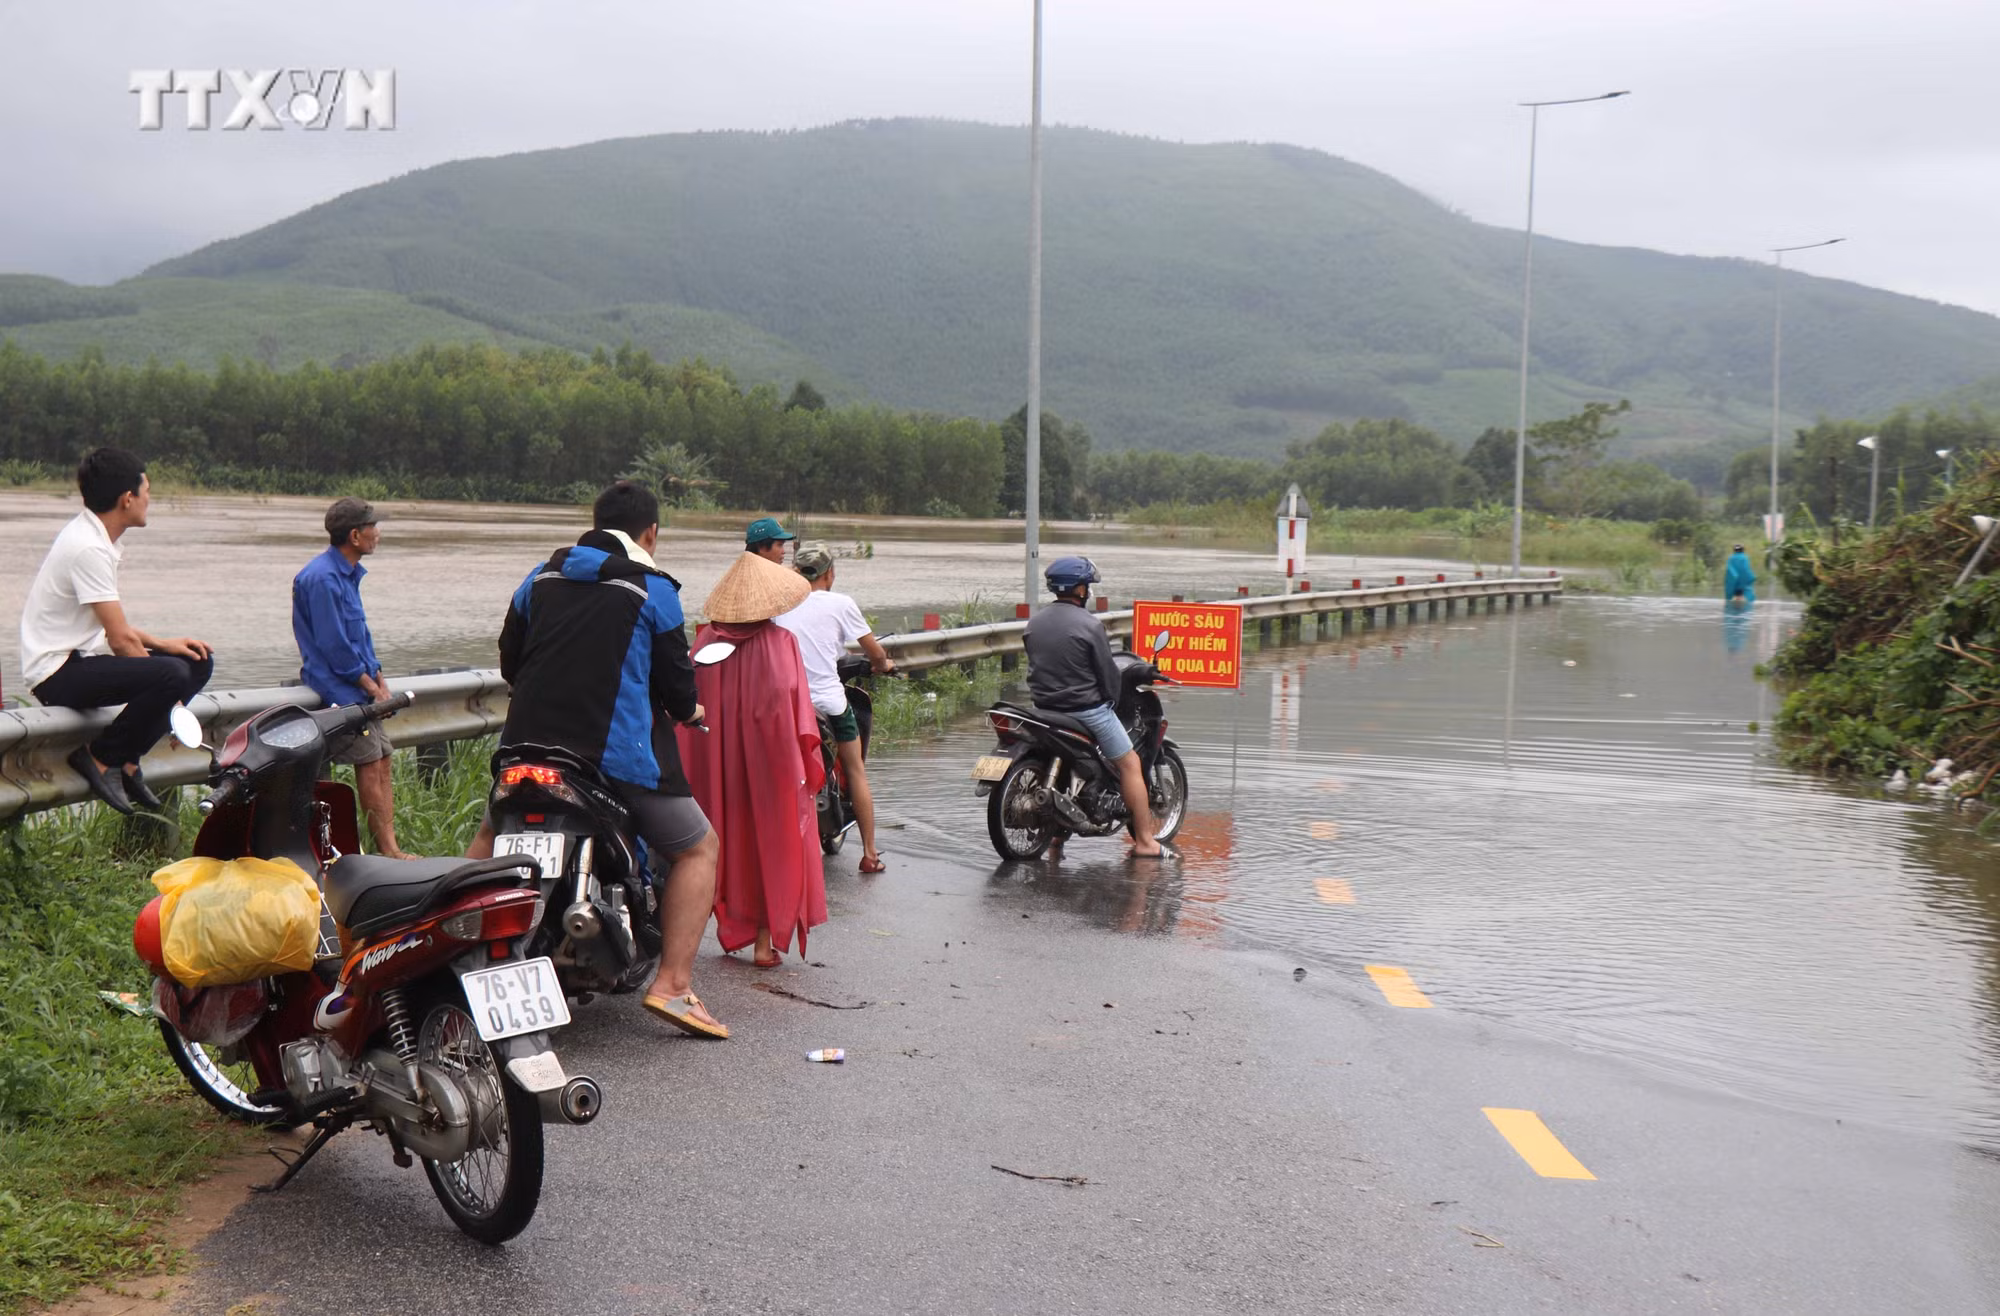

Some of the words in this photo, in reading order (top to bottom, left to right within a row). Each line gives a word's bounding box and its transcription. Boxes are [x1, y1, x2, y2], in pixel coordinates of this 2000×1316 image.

[1149, 611, 1190, 628] NƯỚC
[1194, 613, 1225, 629] SÂU
[1145, 635, 1184, 650] NUY
[1176, 659, 1205, 674] QUA
[1209, 661, 1233, 677] LẠI
[506, 836, 552, 854] 76-F1
[476, 965, 542, 1004] 76-V7
[488, 995, 556, 1034] 0459
